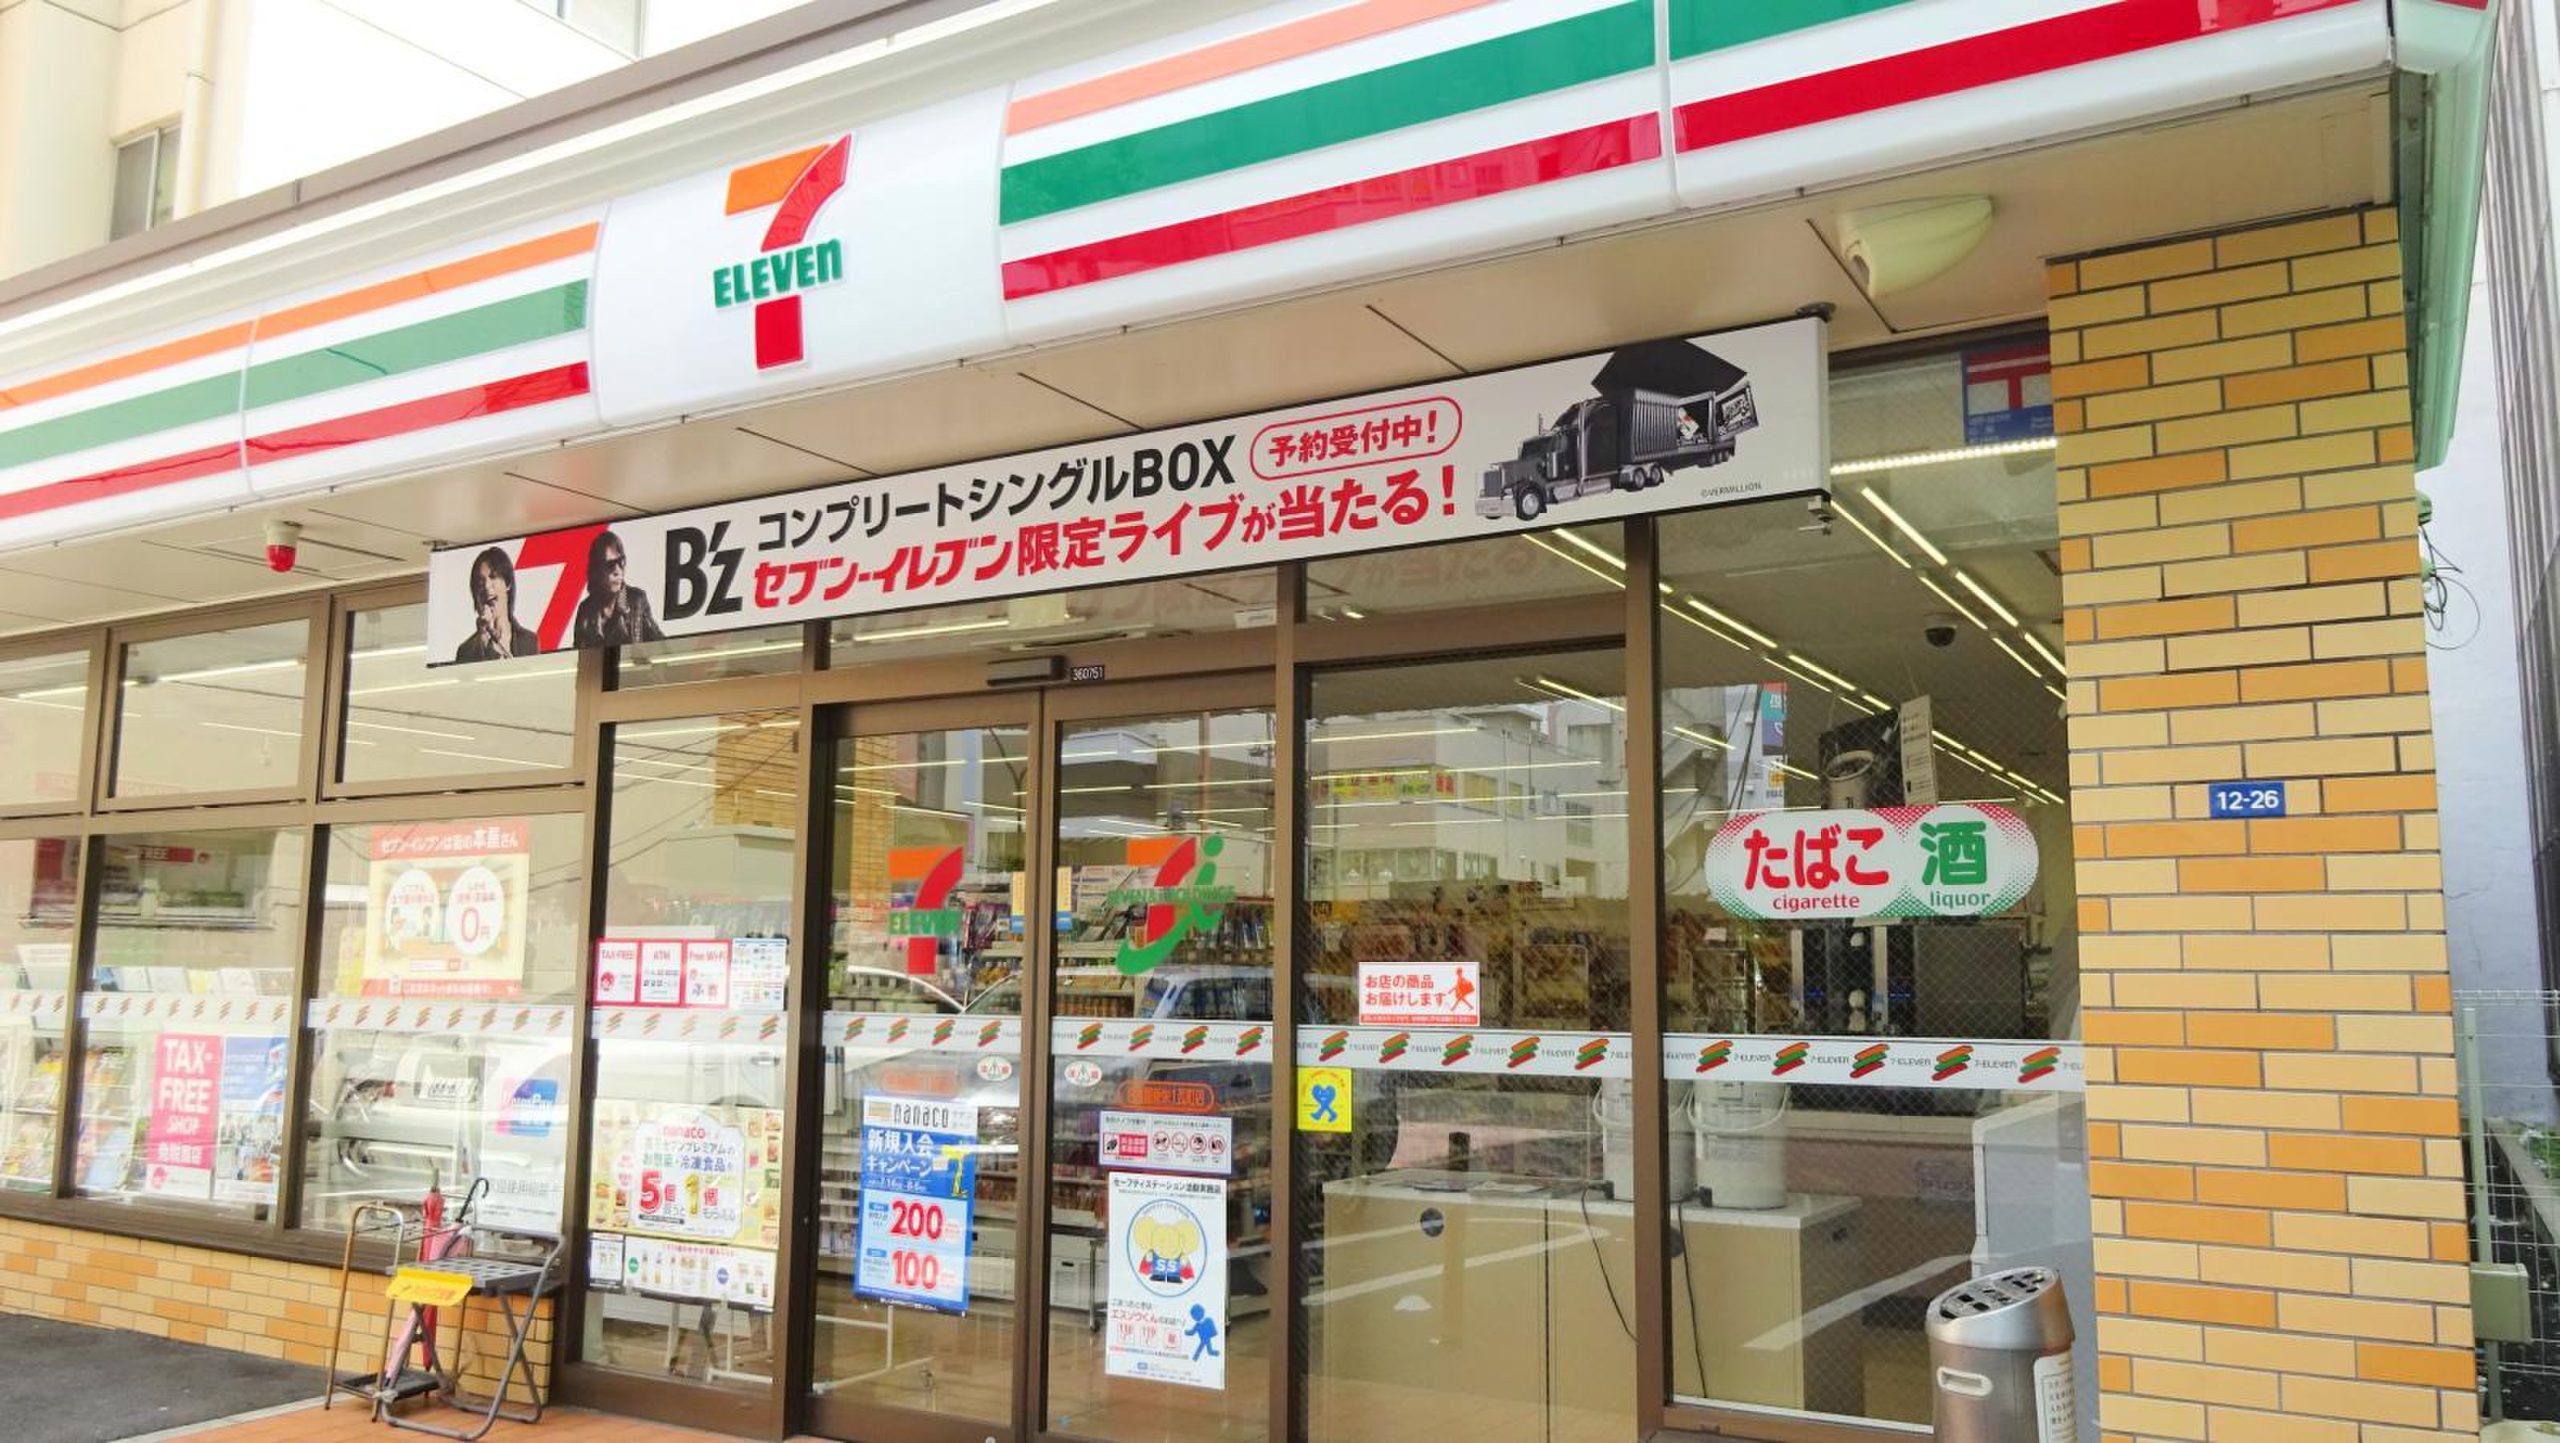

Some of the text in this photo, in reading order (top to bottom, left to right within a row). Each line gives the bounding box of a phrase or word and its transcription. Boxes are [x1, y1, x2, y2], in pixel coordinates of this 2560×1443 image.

[725, 133, 851, 369] 7
[1269, 411, 1438, 468] 予約受付中!
[759, 435, 1236, 552] コンプリートシングルBOX
[754, 466, 1456, 609] セブン-イレブン限定ライブが当たる!
[664, 521, 746, 621] B'z
[2216, 790, 2280, 812] 12-26
[1742, 824, 1890, 890] たばこ
[1920, 820, 1987, 886] 酒
[1772, 892, 1861, 913] cigarette
[1929, 888, 1992, 909] liquor
[1365, 974, 1434, 989] お店の商品
[1365, 991, 1447, 1008] お届けします
[163, 1039, 214, 1074] TAX-
[158, 1077, 213, 1113] FREE
[166, 1115, 199, 1135] SHOP
[894, 1103, 949, 1129] nanaco
[867, 1128, 934, 1157] 新規入会
[866, 1154, 932, 1177] キャンペーン
[891, 1199, 944, 1240] 200
[892, 1250, 940, 1290] 100
